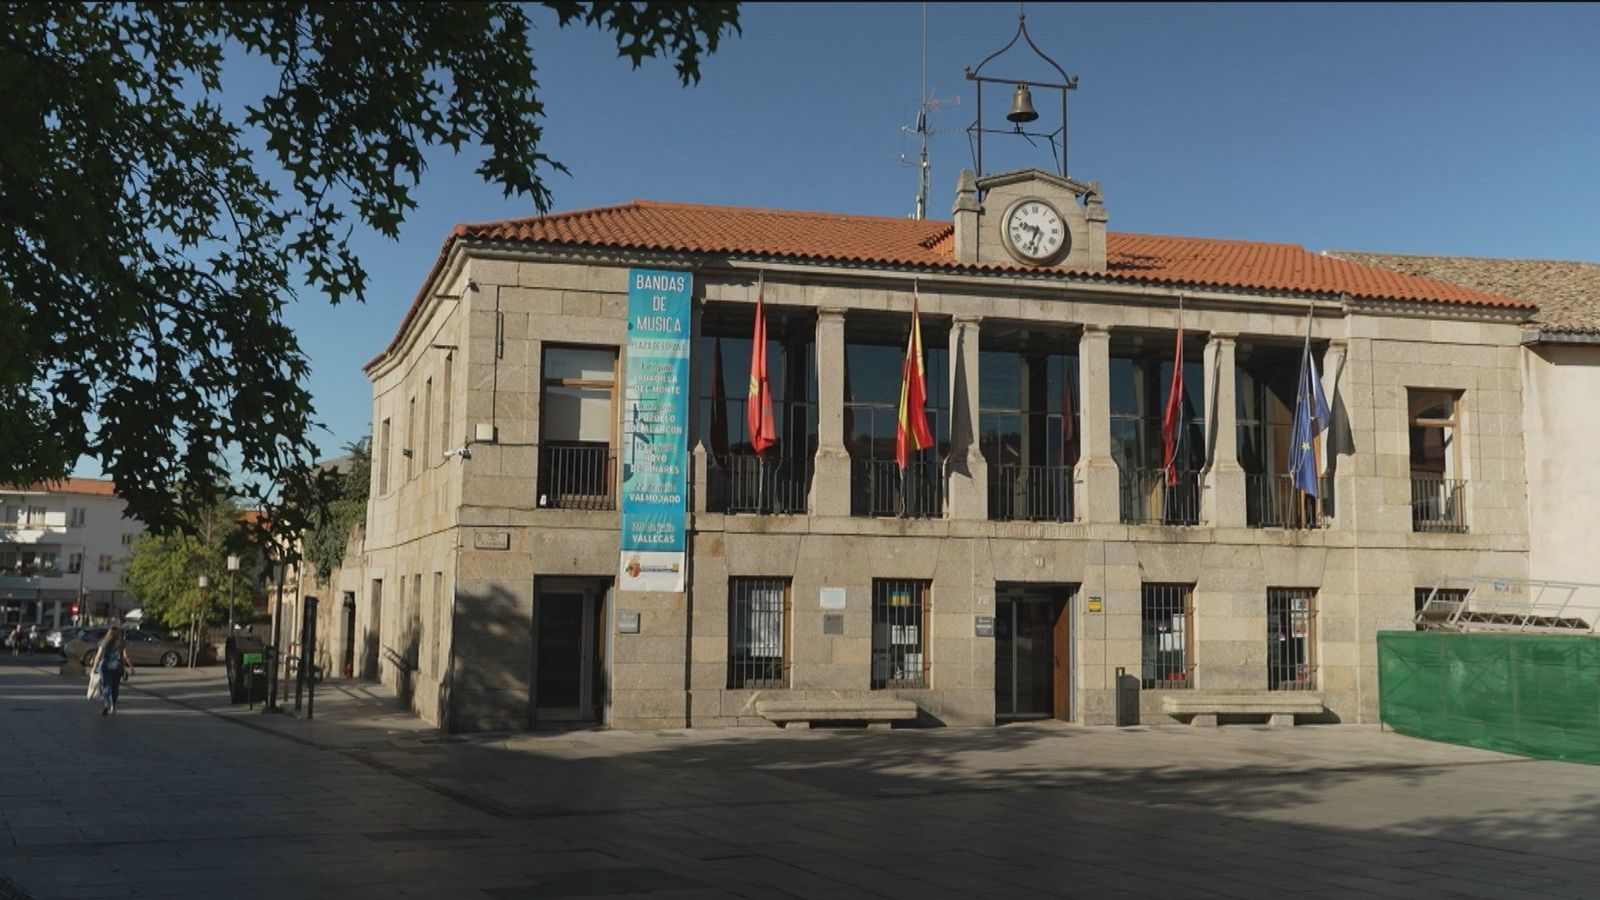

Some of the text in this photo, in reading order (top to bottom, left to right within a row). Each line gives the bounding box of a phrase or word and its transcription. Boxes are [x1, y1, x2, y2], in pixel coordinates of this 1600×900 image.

[636, 274, 685, 292] BANDAS
[652, 296, 667, 311] DE
[636, 316, 682, 333] MUSICA
[632, 341, 651, 350] PLAZA
[652, 386, 680, 394] MONTE
[639, 413, 676, 422] POZUELO
[629, 493, 681, 503] VALMOJADO
[632, 534, 676, 544] VALLECAS
